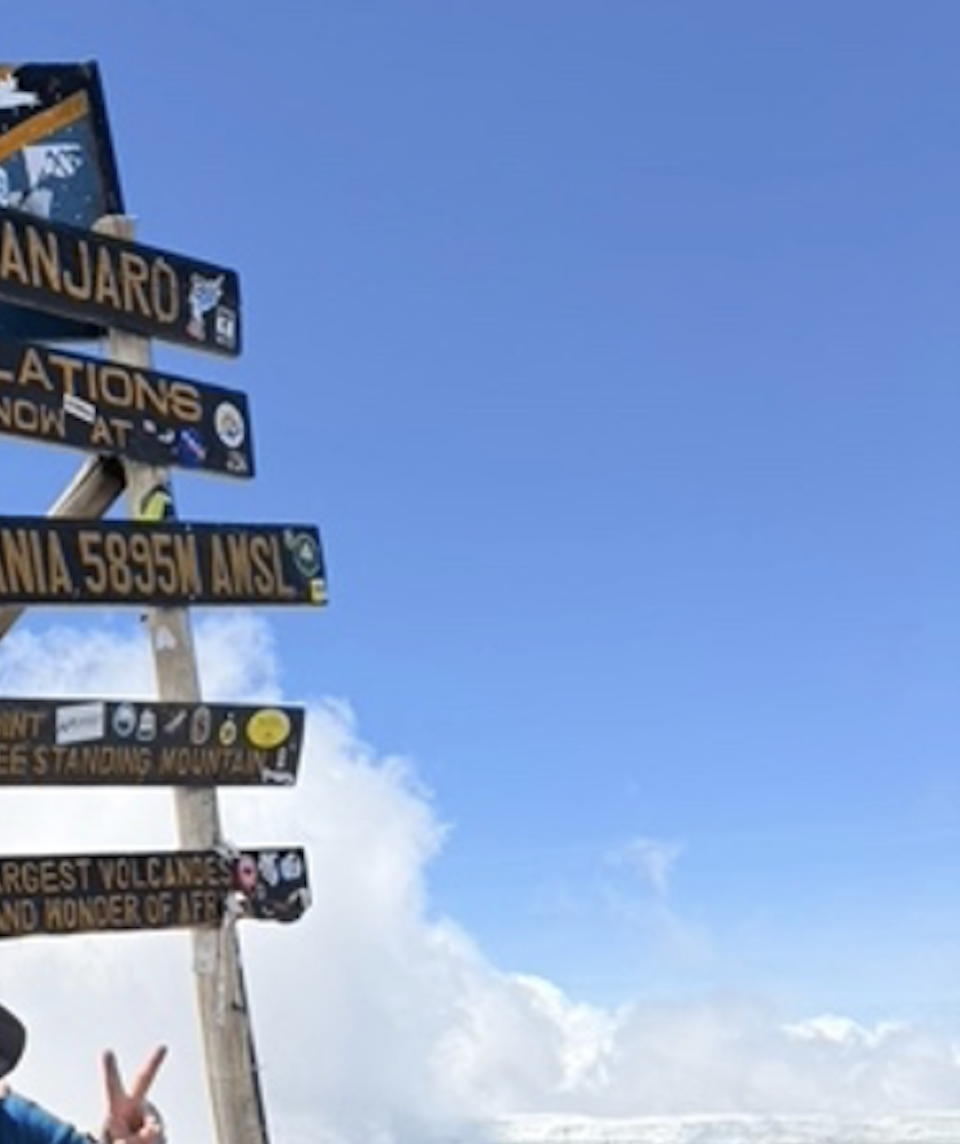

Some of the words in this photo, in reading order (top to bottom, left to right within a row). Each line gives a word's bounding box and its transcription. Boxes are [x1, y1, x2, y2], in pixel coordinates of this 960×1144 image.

[91, 415, 134, 449] AT
[211, 532, 296, 597] AMSL
[44, 893, 141, 930] WONDER
[147, 891, 173, 924] OF
